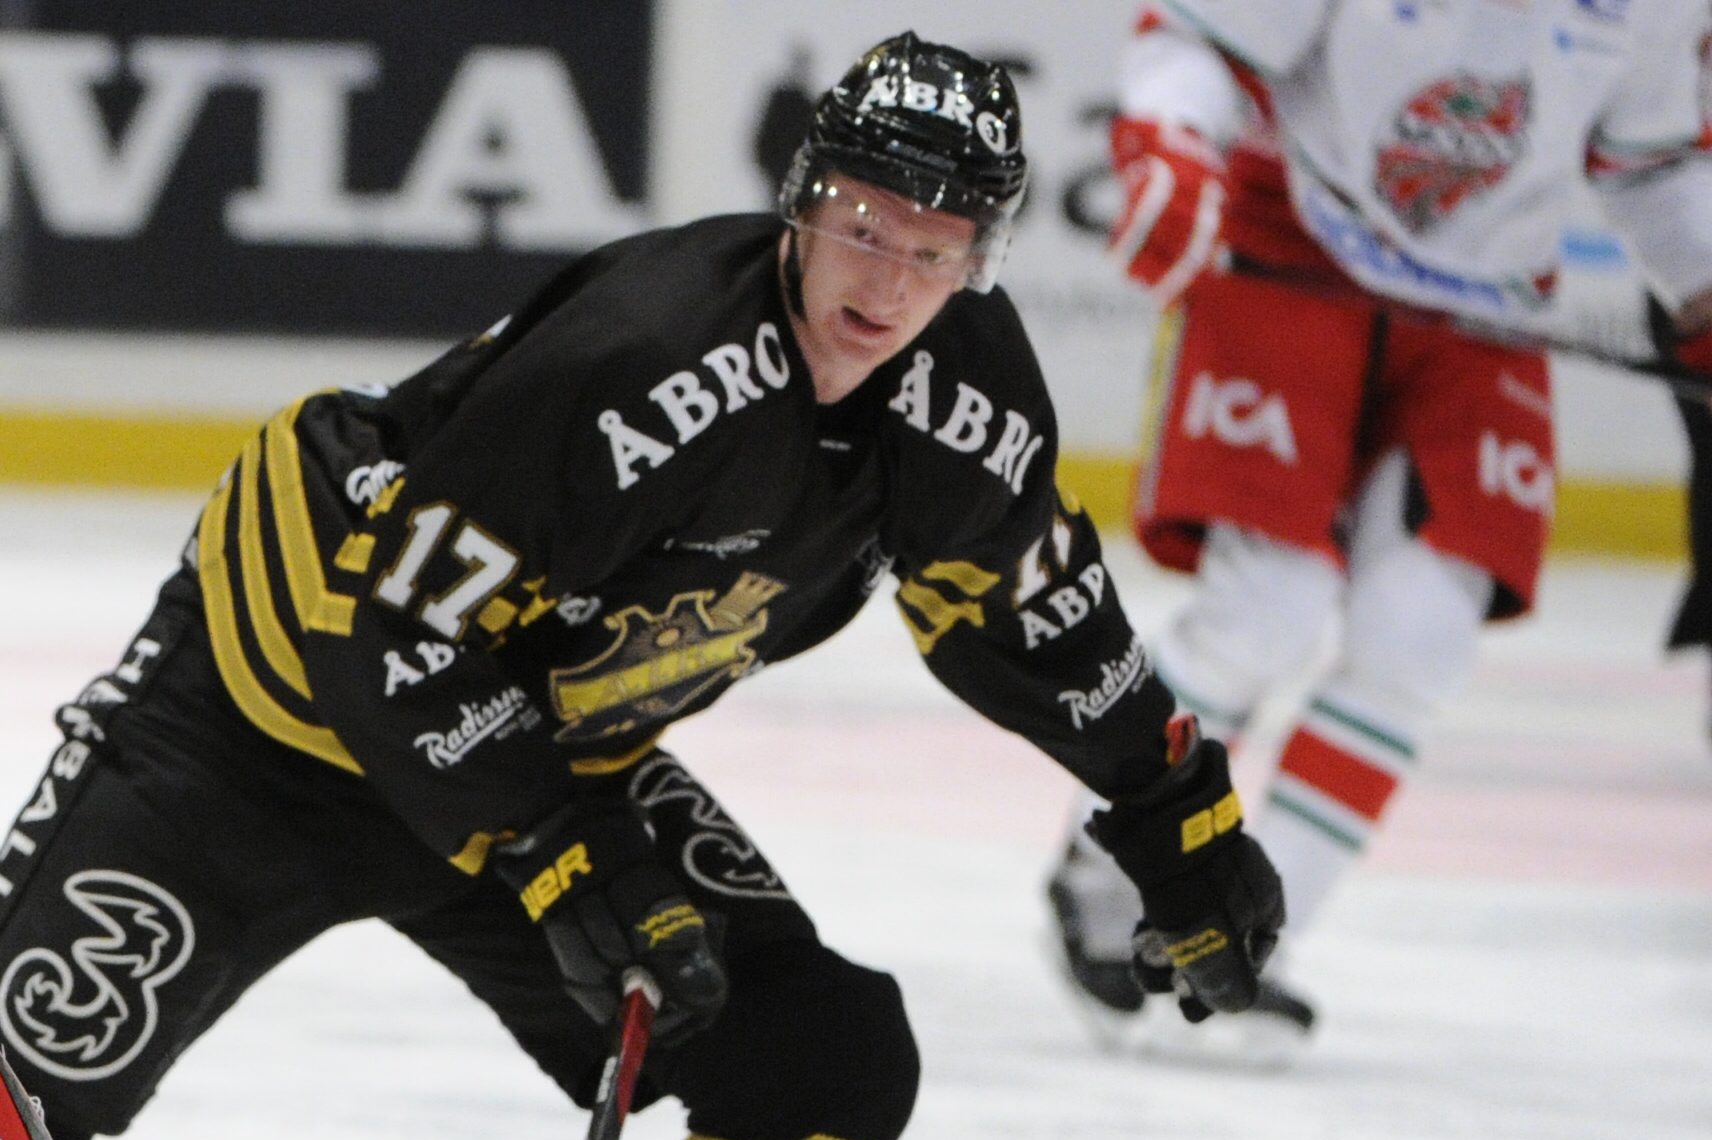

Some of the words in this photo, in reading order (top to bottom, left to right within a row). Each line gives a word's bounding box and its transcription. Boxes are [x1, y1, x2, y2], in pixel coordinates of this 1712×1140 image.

[598, 322, 791, 491] ÅBRO
[1181, 377, 1298, 466] ICA
[372, 501, 524, 641] 17
